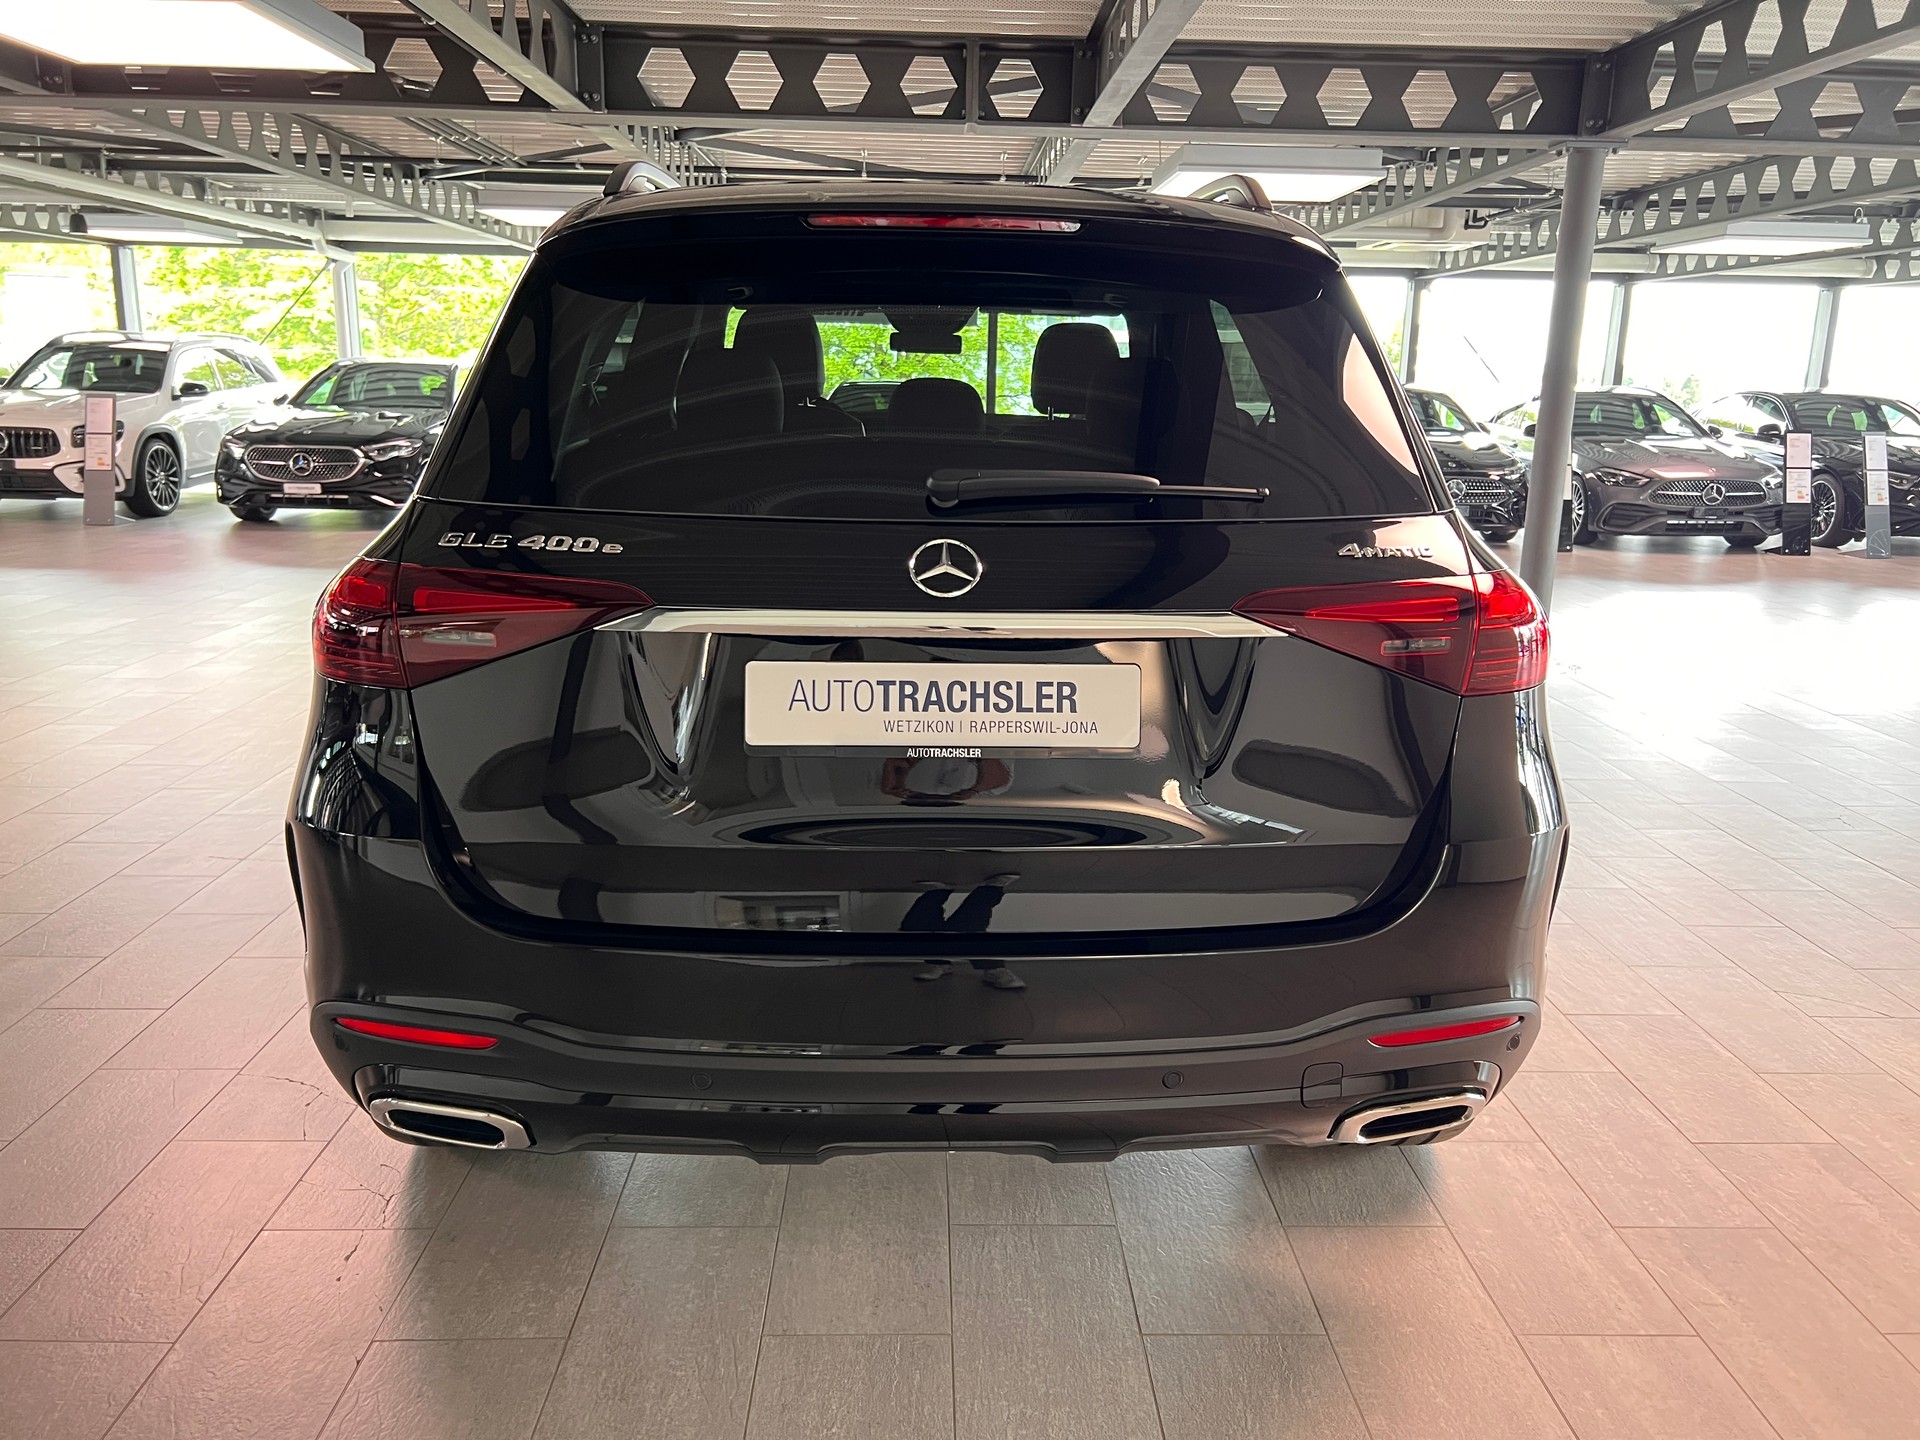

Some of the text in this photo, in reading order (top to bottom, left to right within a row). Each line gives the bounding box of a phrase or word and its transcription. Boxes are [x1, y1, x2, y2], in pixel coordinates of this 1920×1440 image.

[438, 532, 512, 549] GLE
[1337, 542, 1433, 558] 4MATIC
[789, 679, 1077, 714] AUTOTRACHSLER
[883, 720, 1099, 735] WETZIKON RAPPERSWIL-JONA
[906, 747, 982, 758] AUTOTRACHSLER
